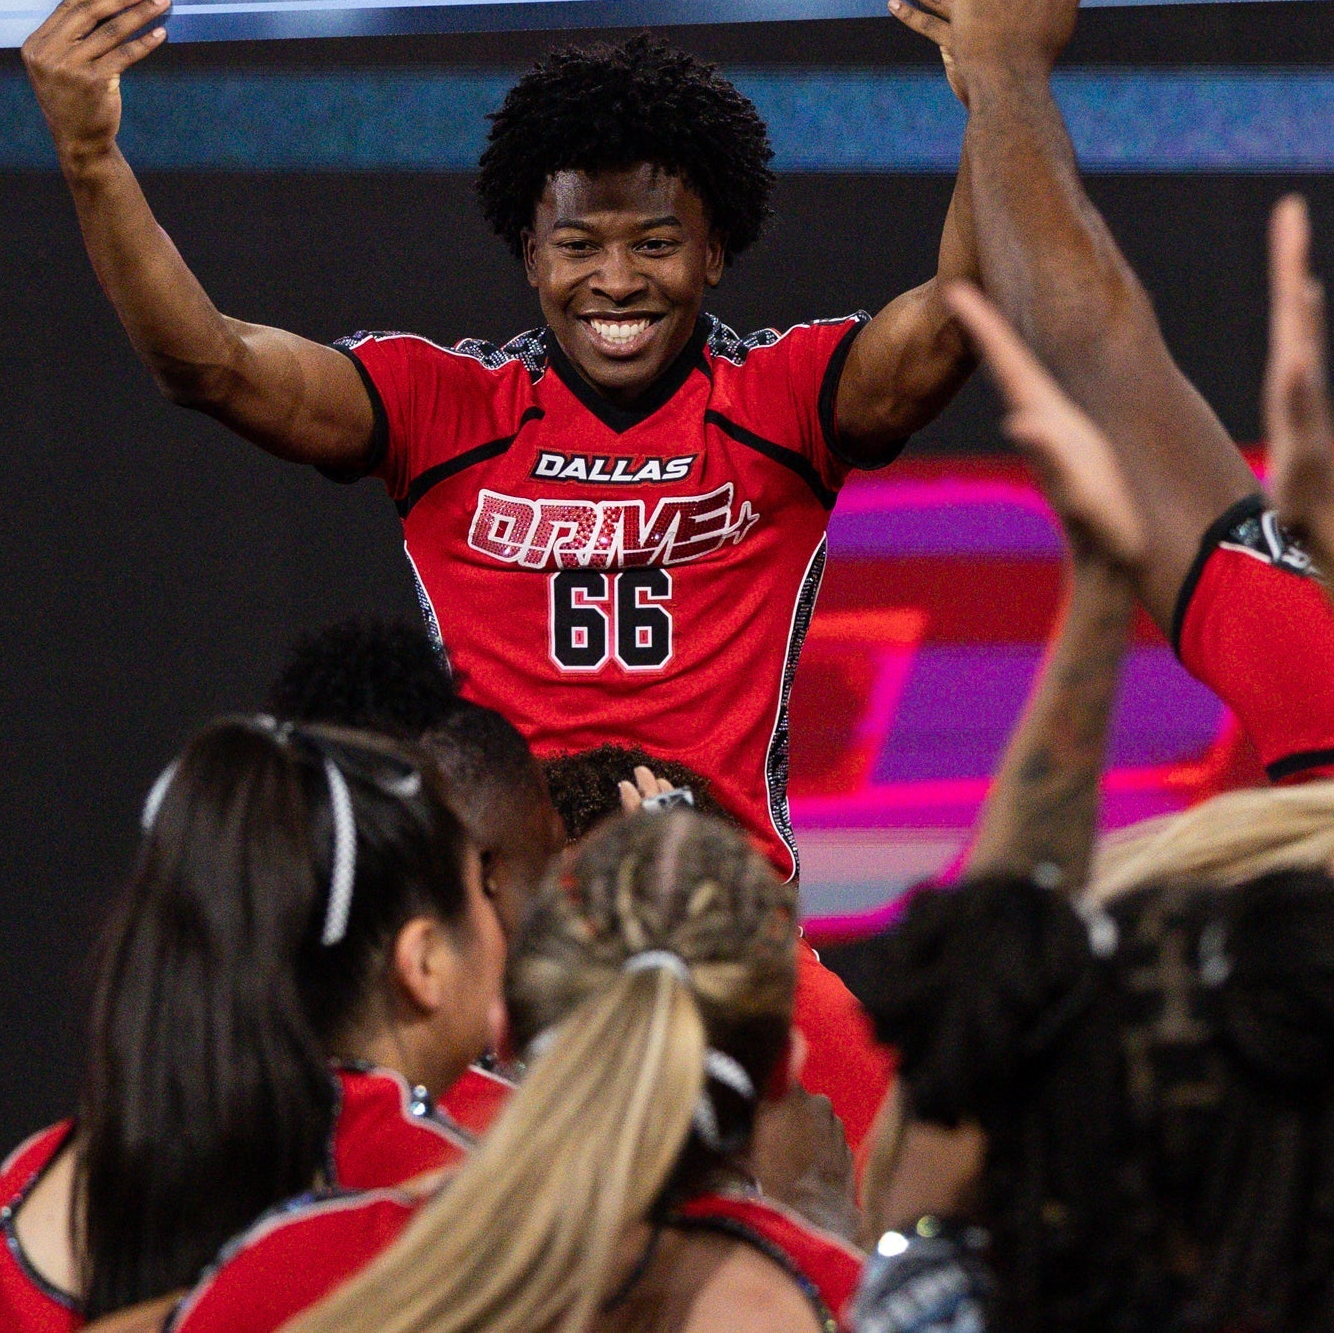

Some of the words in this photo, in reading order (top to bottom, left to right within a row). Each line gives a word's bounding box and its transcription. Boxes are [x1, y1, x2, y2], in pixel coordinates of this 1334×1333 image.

[535, 452, 694, 482] DALLAS
[468, 482, 737, 569] DRIVE
[551, 569, 673, 673] 66
